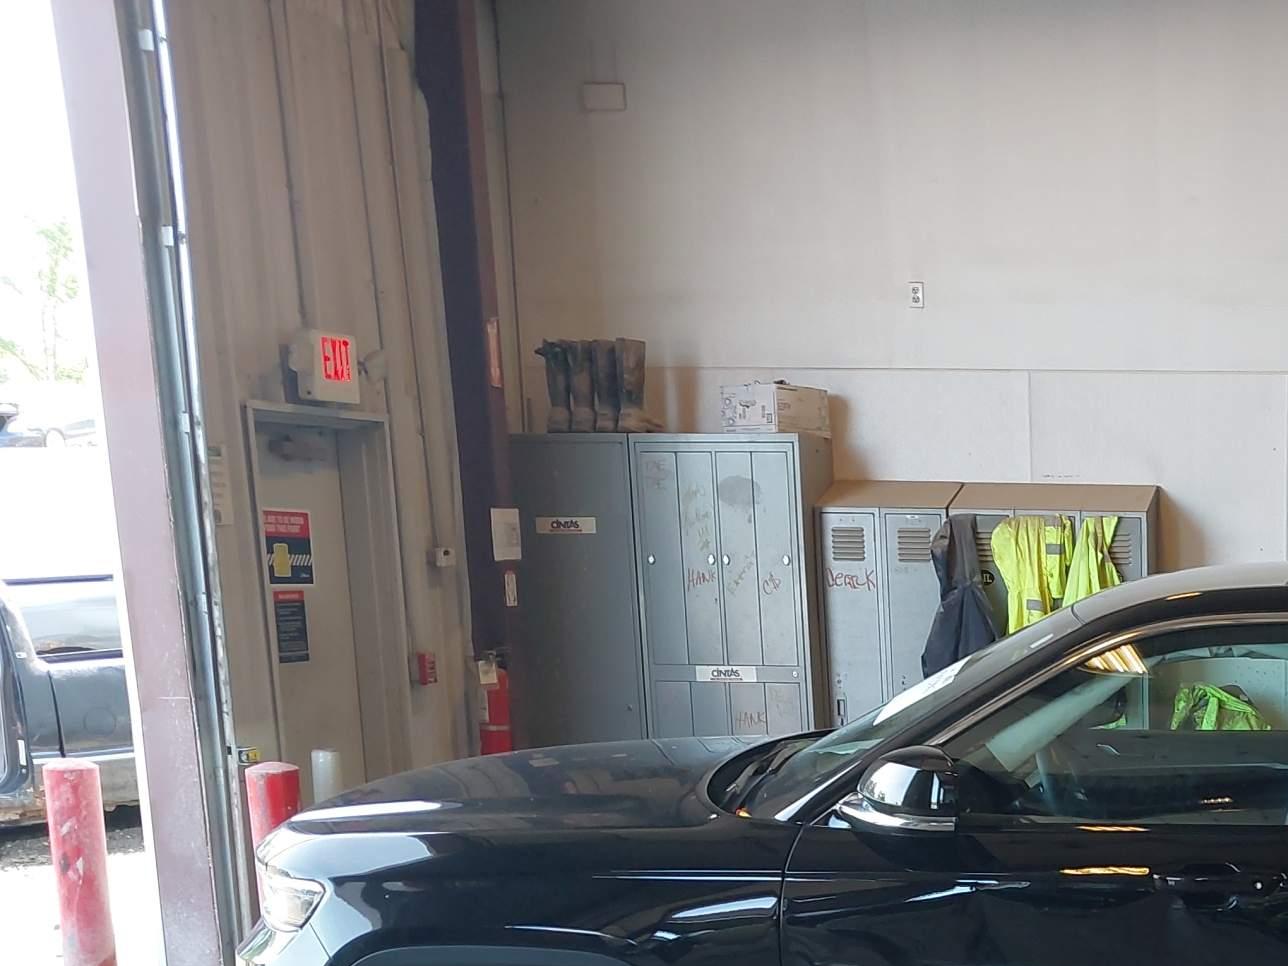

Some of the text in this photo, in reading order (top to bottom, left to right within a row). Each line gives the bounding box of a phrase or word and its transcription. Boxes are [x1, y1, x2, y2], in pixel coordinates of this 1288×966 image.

[321, 336, 351, 381] EXIT
[687, 567, 716, 592] HANK
[735, 711, 767, 729] HANK
